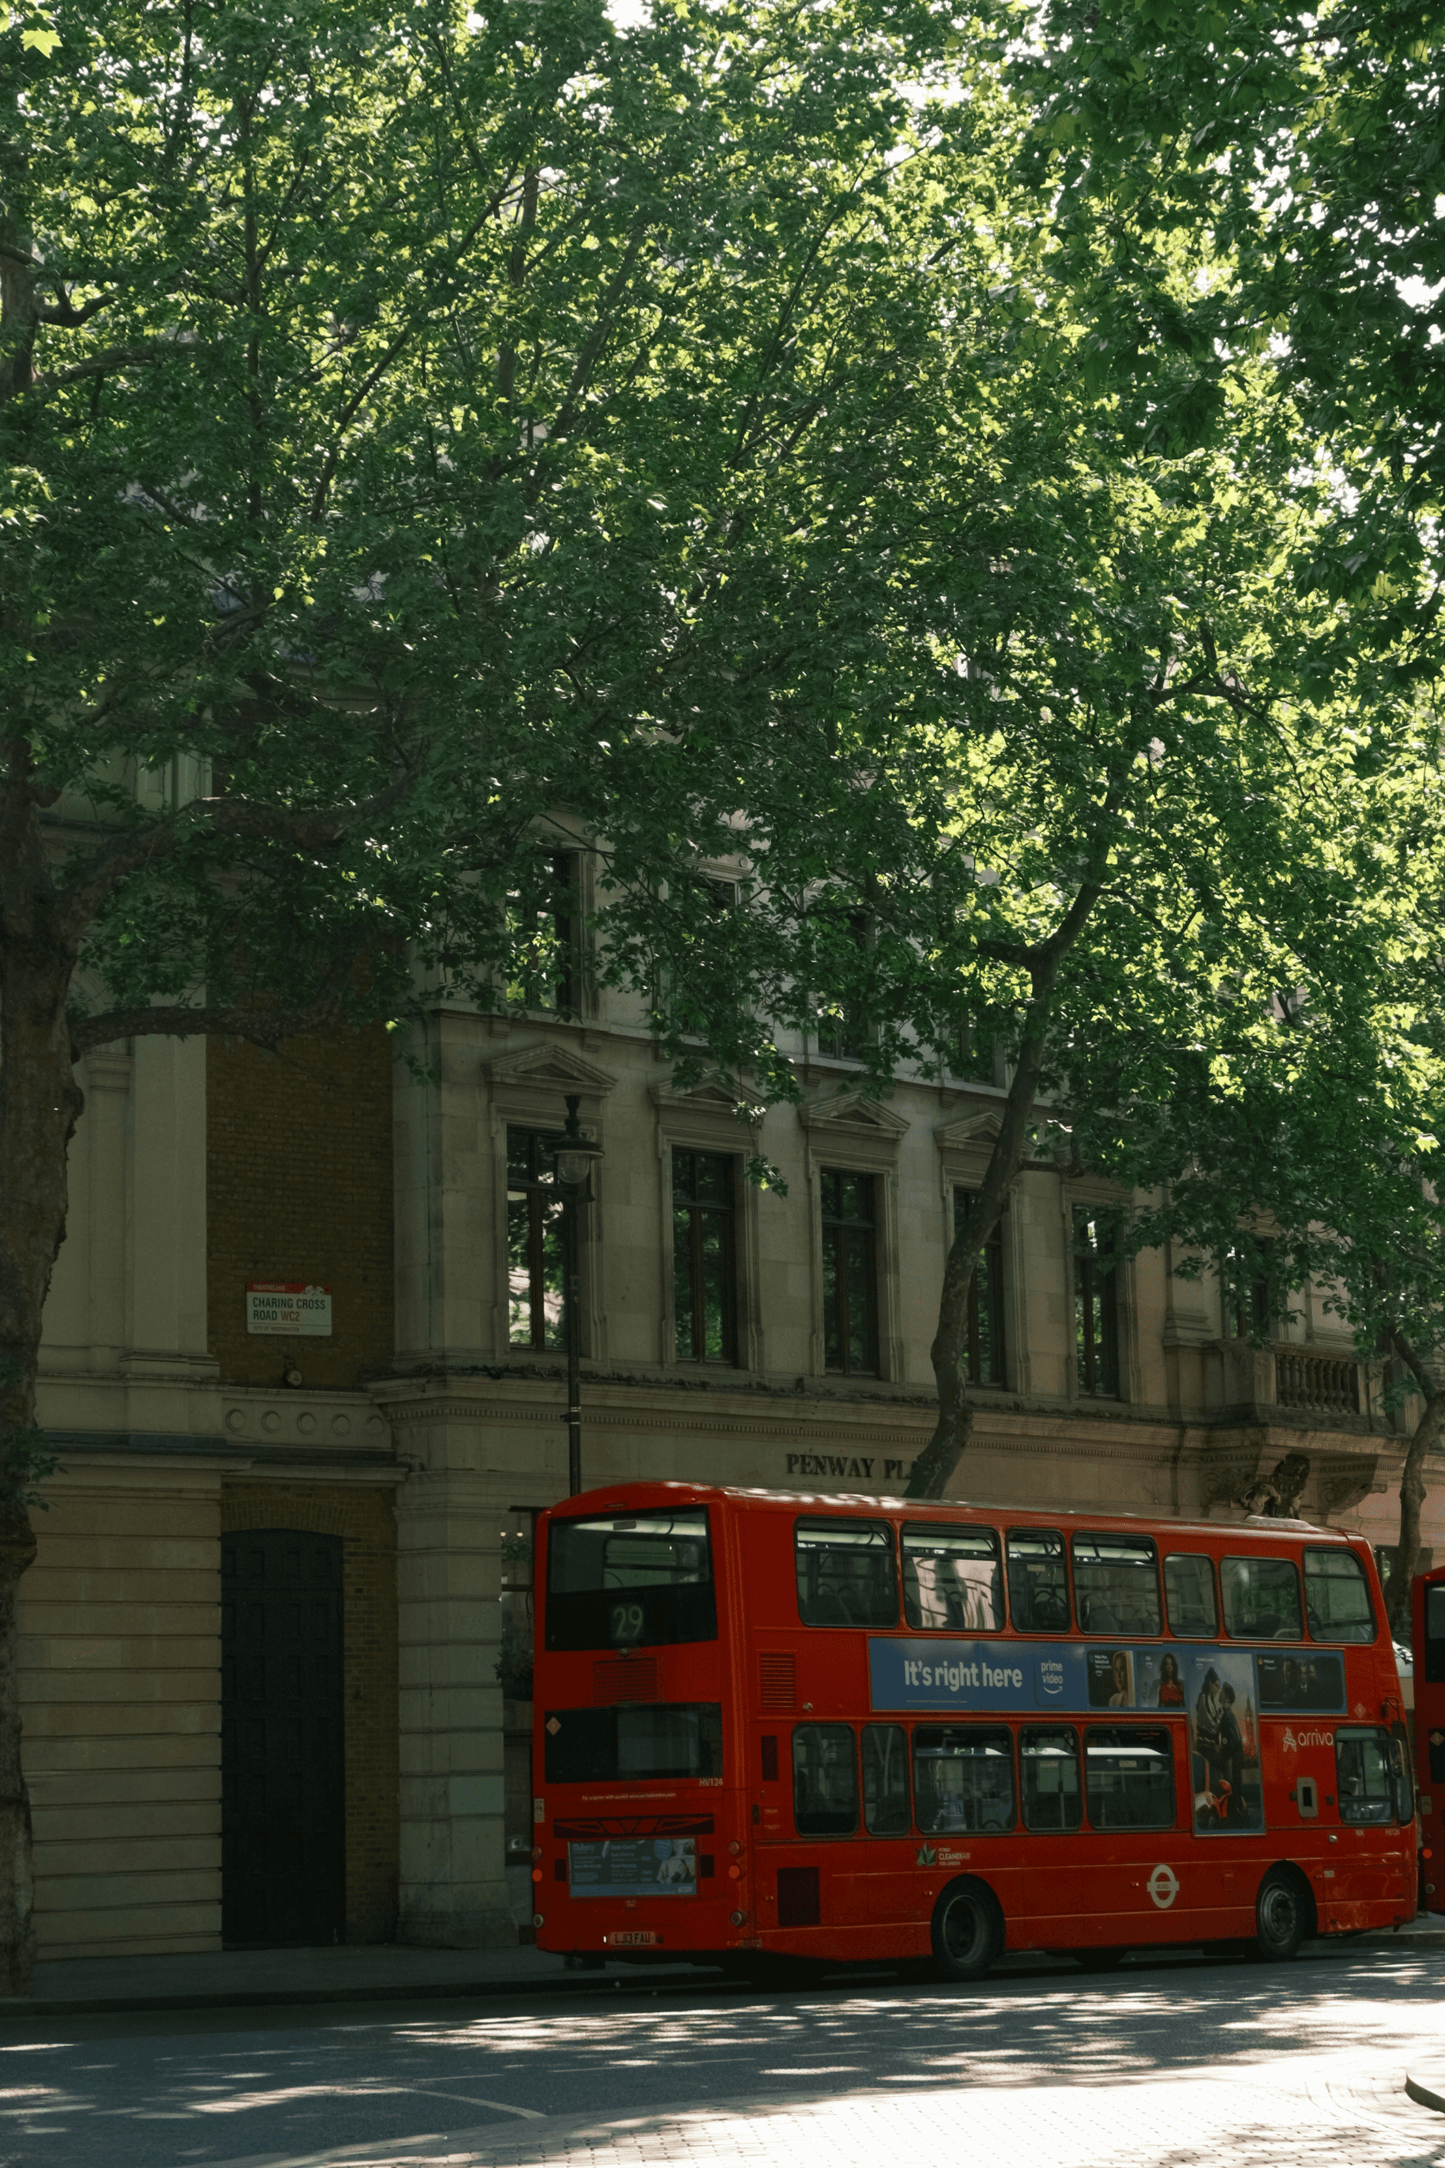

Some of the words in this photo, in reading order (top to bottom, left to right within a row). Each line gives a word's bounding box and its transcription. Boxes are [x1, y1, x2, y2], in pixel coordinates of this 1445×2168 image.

[253, 1297, 293, 1308] CHARING
[296, 1298, 326, 1310] CROSS
[253, 1310, 278, 1321] ROAD
[280, 1311, 300, 1322] WC2
[786, 1453, 875, 1478] PENWAY
[613, 1605, 643, 1638] 29
[1040, 1659, 1063, 1674] prime
[904, 1660, 933, 1687] It's
[934, 1660, 980, 1692] right
[982, 1662, 1023, 1688] here
[1041, 1672, 1063, 1684] video
[1298, 1728, 1334, 1746] arriva
[698, 1777, 723, 1787] HV124
